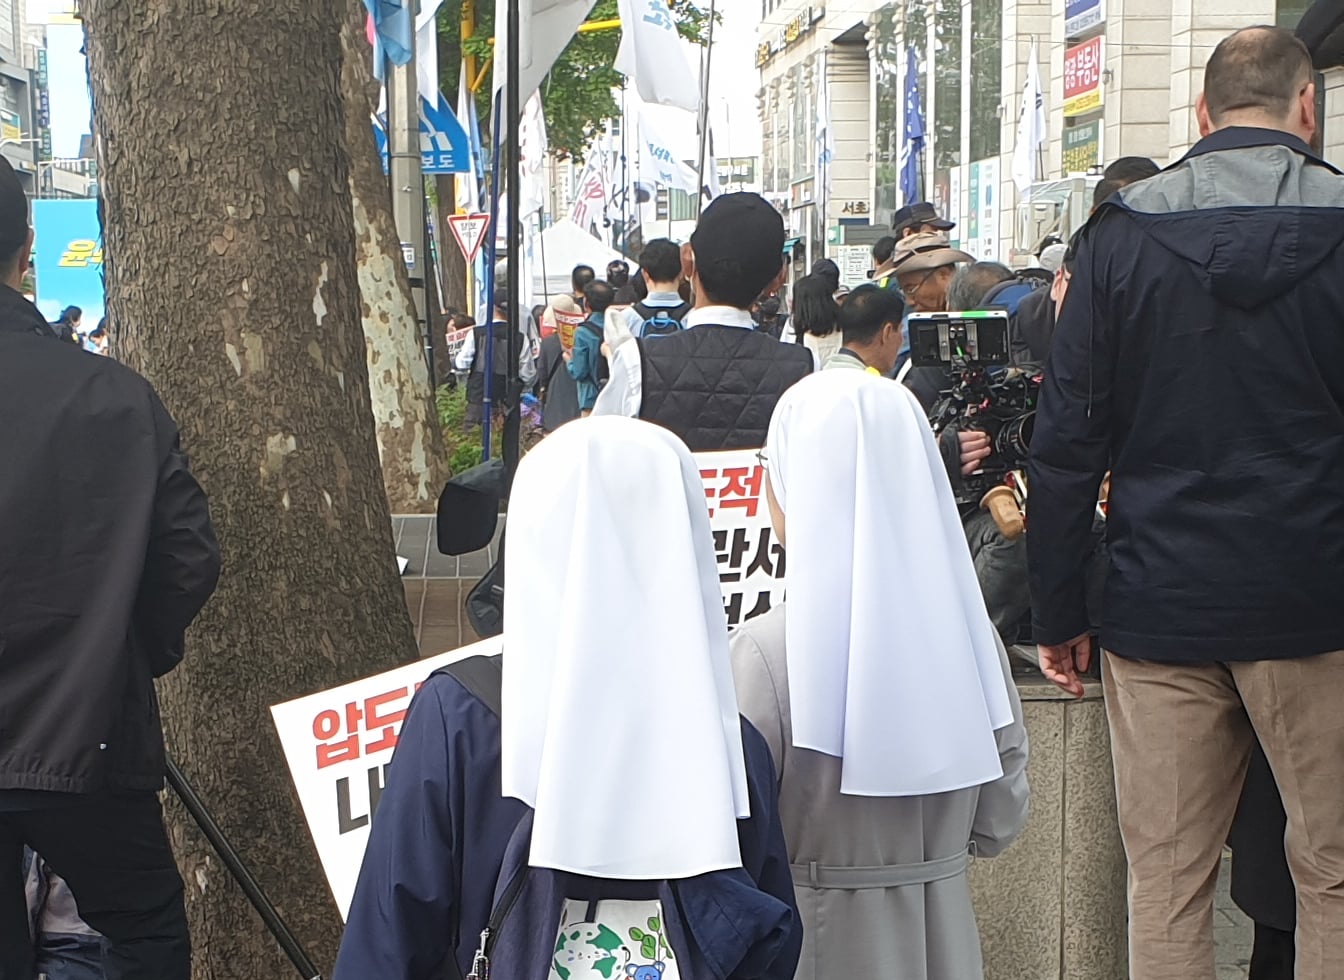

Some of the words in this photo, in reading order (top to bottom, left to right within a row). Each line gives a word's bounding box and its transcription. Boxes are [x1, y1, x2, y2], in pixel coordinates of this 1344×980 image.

[421, 154, 456, 170] 보도
[842, 201, 870, 215] 서초
[699, 465, 764, 519] 도적
[312, 685, 410, 770] 압도
